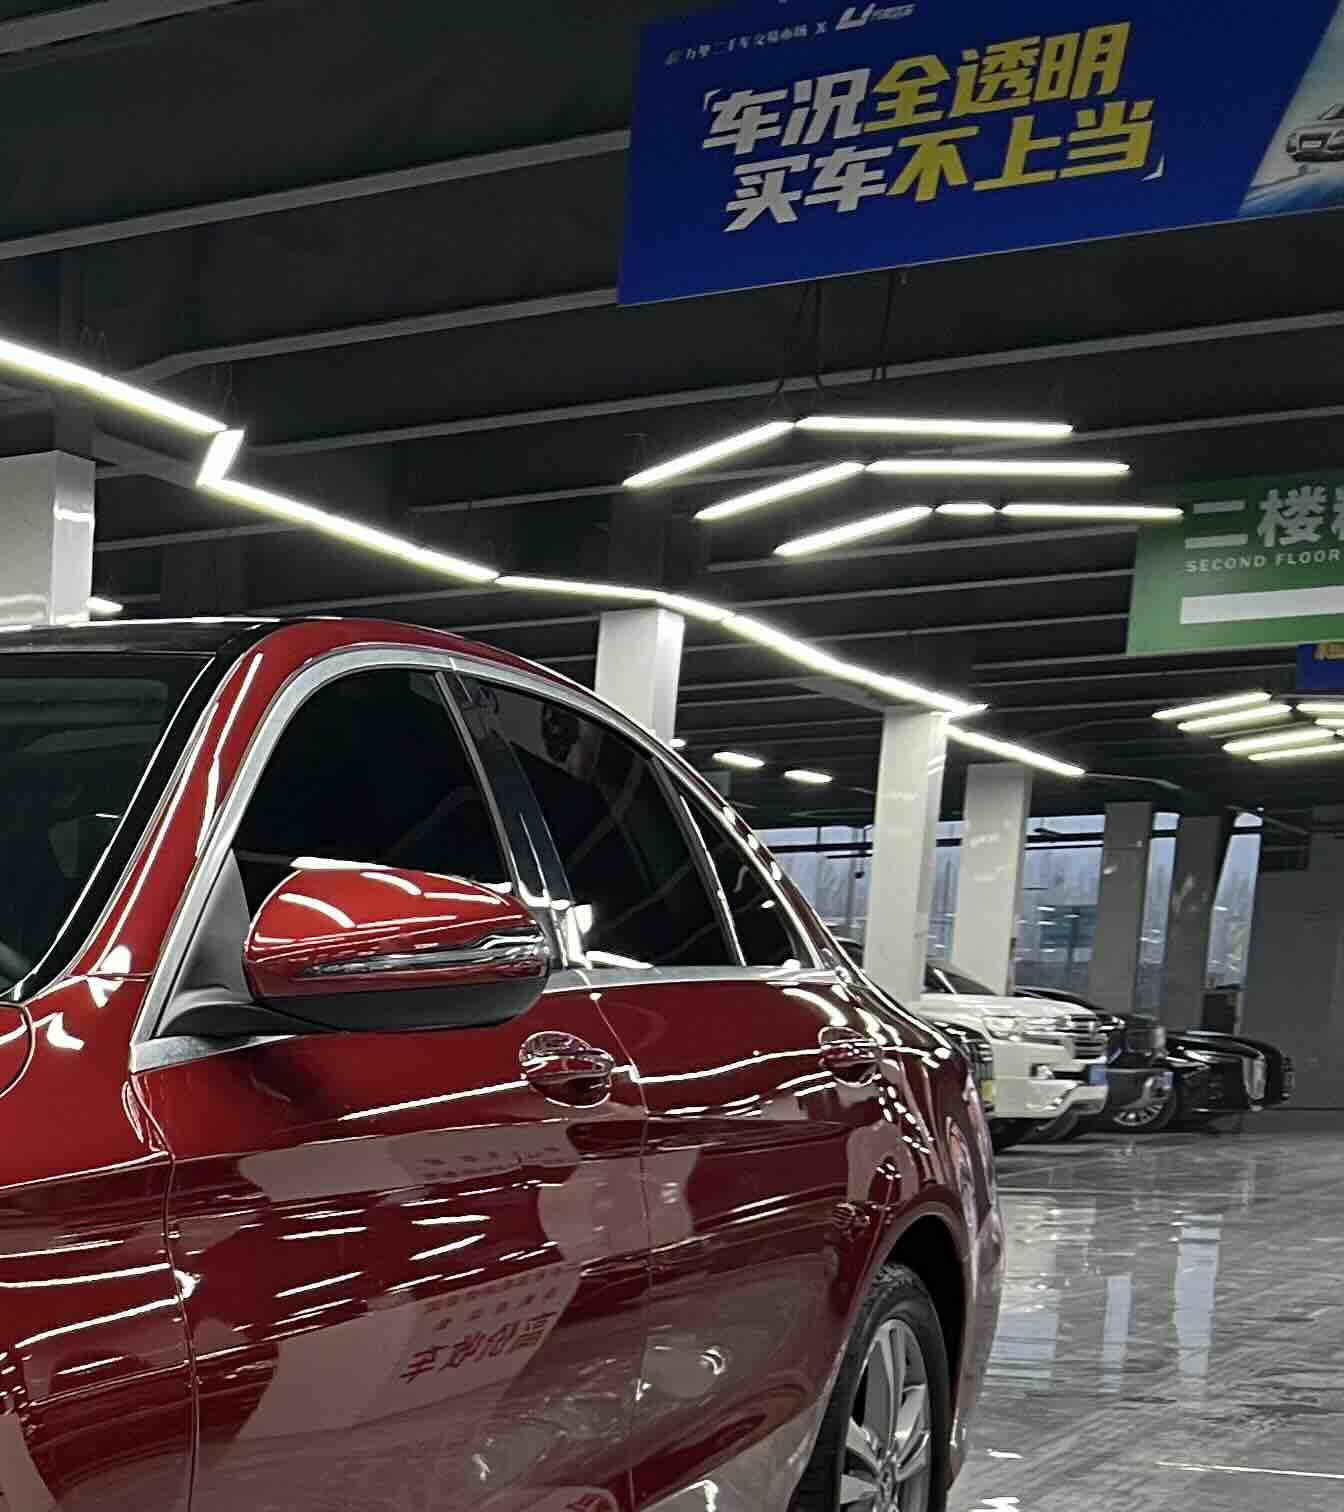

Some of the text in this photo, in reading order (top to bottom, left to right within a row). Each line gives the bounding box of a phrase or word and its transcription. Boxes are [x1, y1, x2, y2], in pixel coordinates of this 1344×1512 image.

[1184, 485, 1344, 550] 二楼
[1184, 549, 1341, 573] SECOND FLOOR
